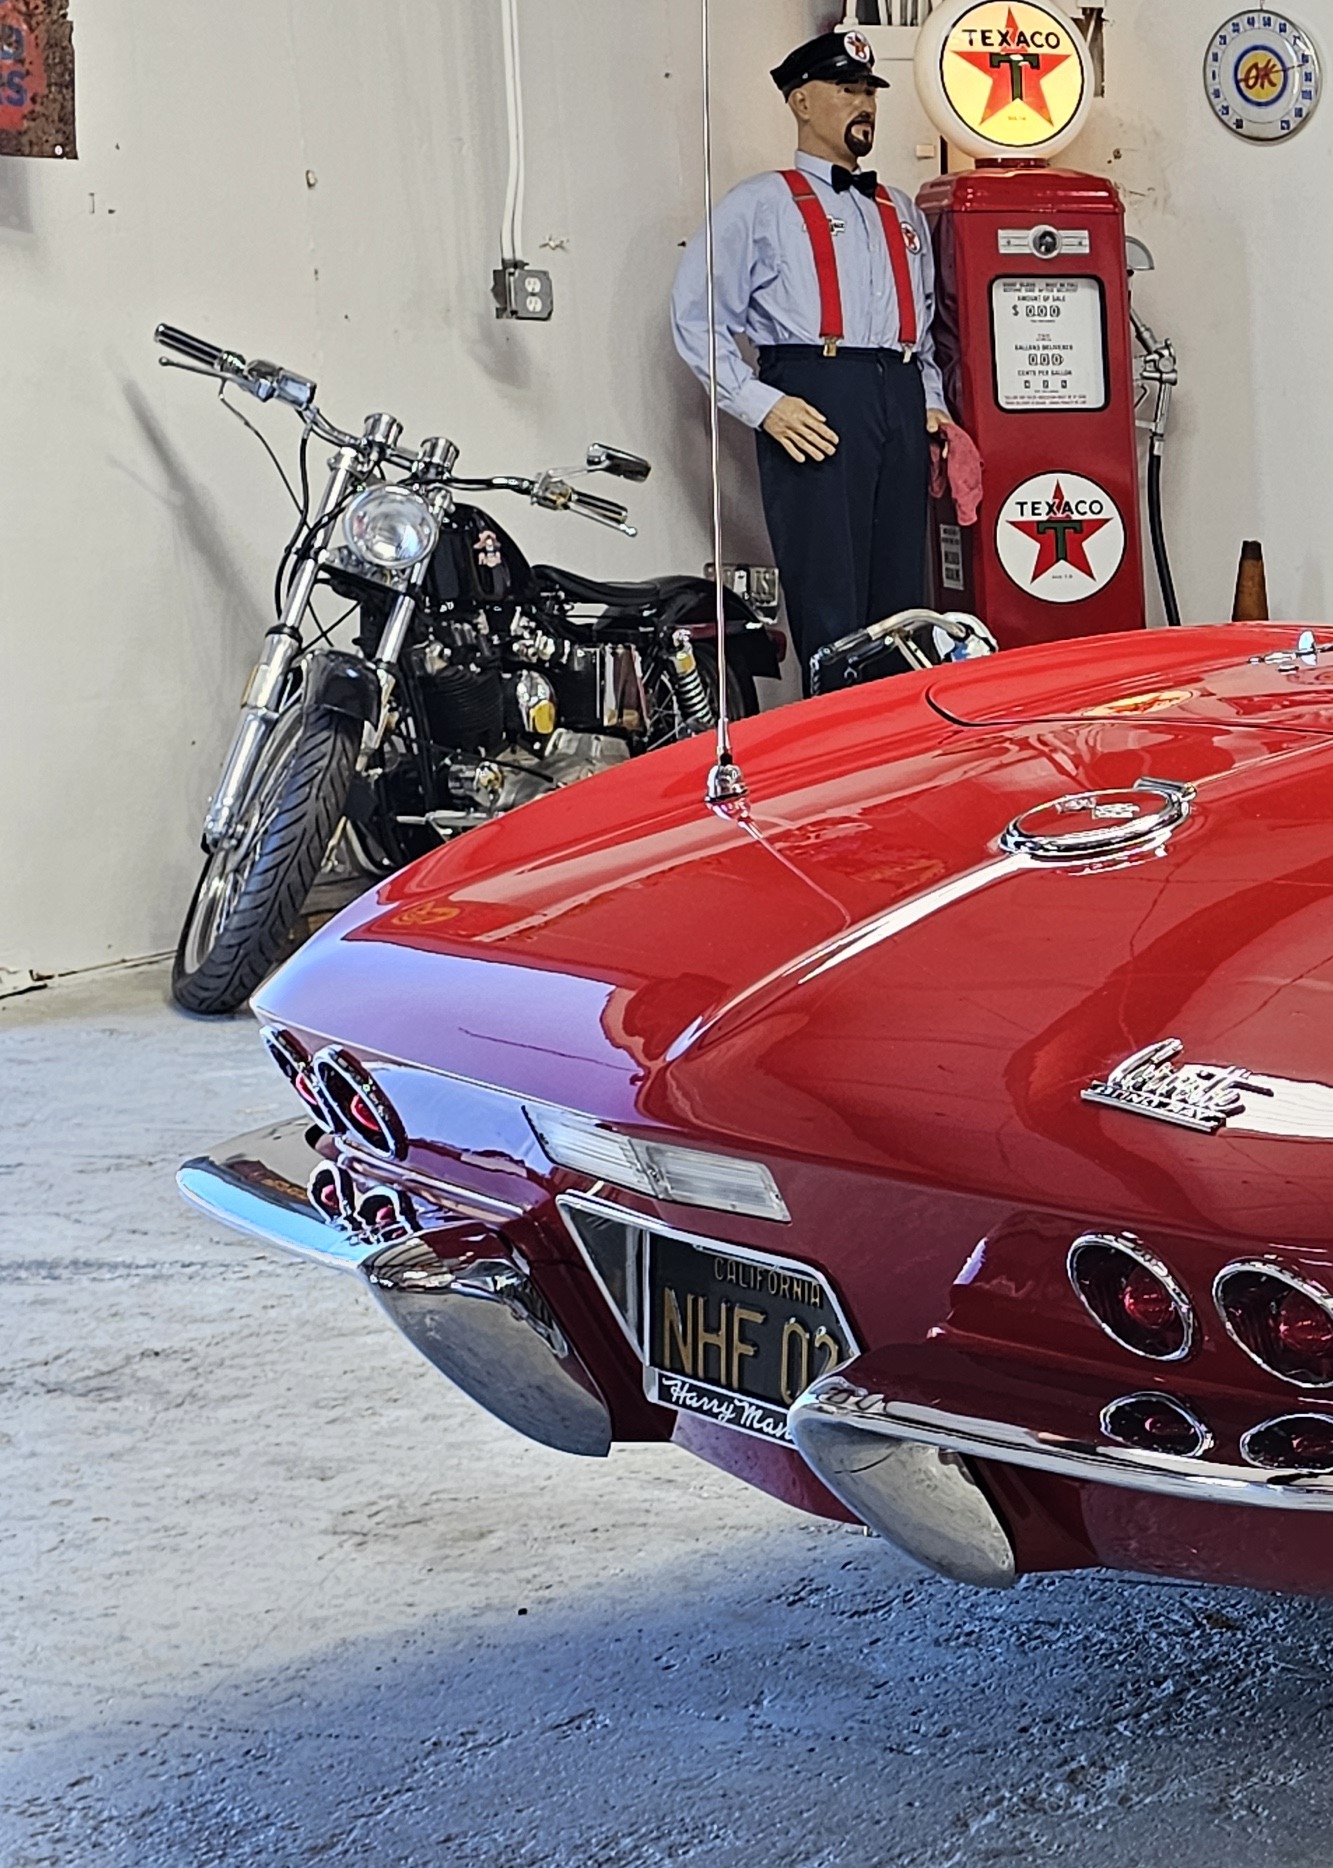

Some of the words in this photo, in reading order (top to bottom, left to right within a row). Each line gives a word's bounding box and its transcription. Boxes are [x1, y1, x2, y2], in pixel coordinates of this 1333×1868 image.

[962, 29, 1061, 49] TEXACO
[1244, 58, 1278, 90] OK
[1015, 499, 1104, 517] TEXACO
[713, 1256, 821, 1308] CALIFORNIA
[663, 1285, 766, 1391] NHF
[661, 1377, 735, 1424] Harry
